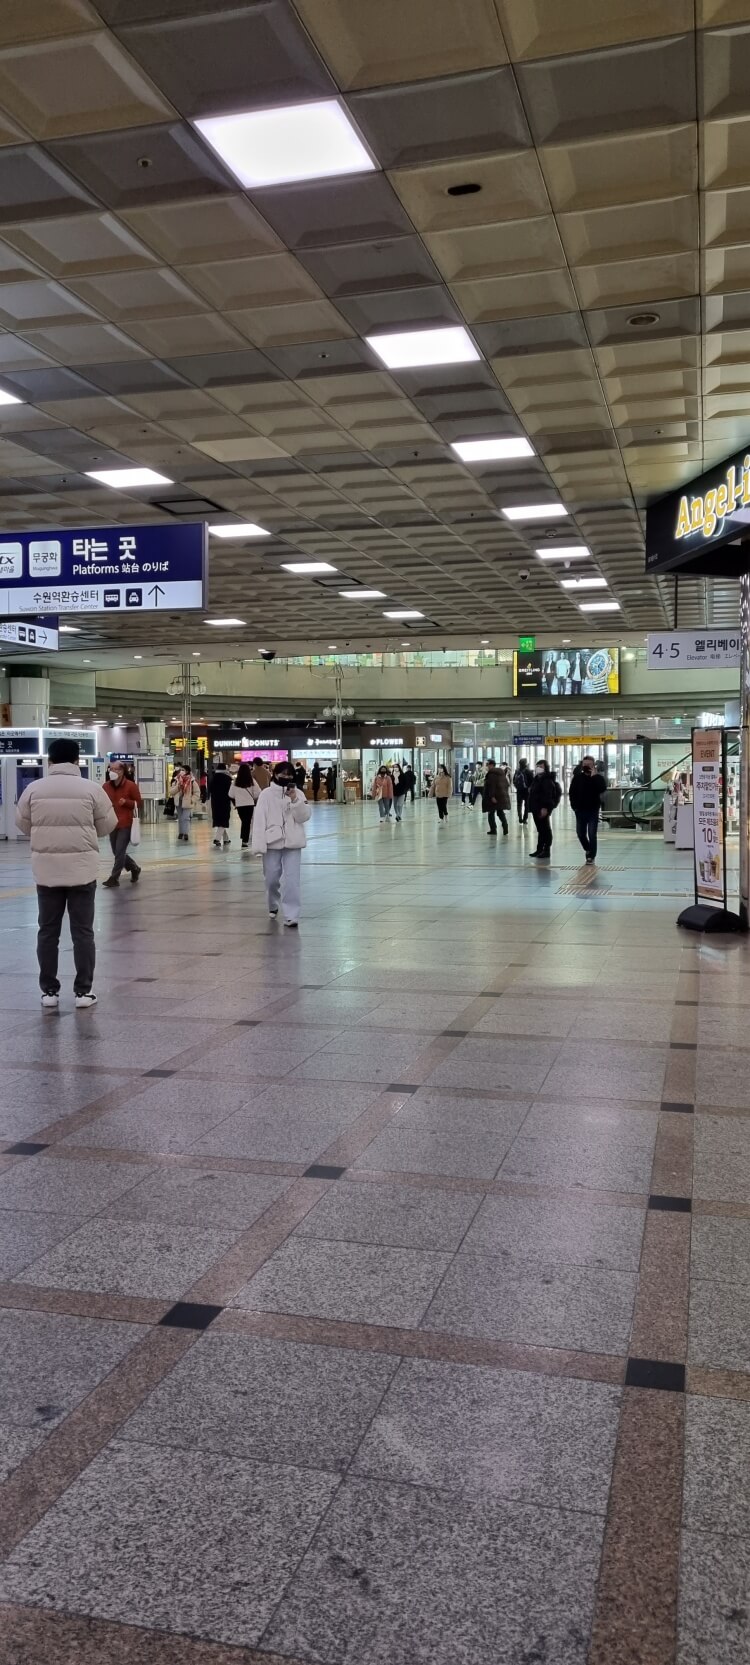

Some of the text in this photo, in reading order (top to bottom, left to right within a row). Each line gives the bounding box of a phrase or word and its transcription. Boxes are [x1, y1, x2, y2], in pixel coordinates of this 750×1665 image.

[72, 536, 137, 561] 타는 곳
[32, 552, 58, 564] 무궁화
[72, 561, 169, 575] Platforms 站台 のりば
[32, 590, 99, 604] 수원역환승센터
[18, 602, 99, 613] Suwon Station Transfer Center
[249, 739, 279, 747] DONUTS
[375, 738, 404, 746] FLOWER
[700, 749, 716, 759] EVENT
[702, 827, 713, 844] 10
